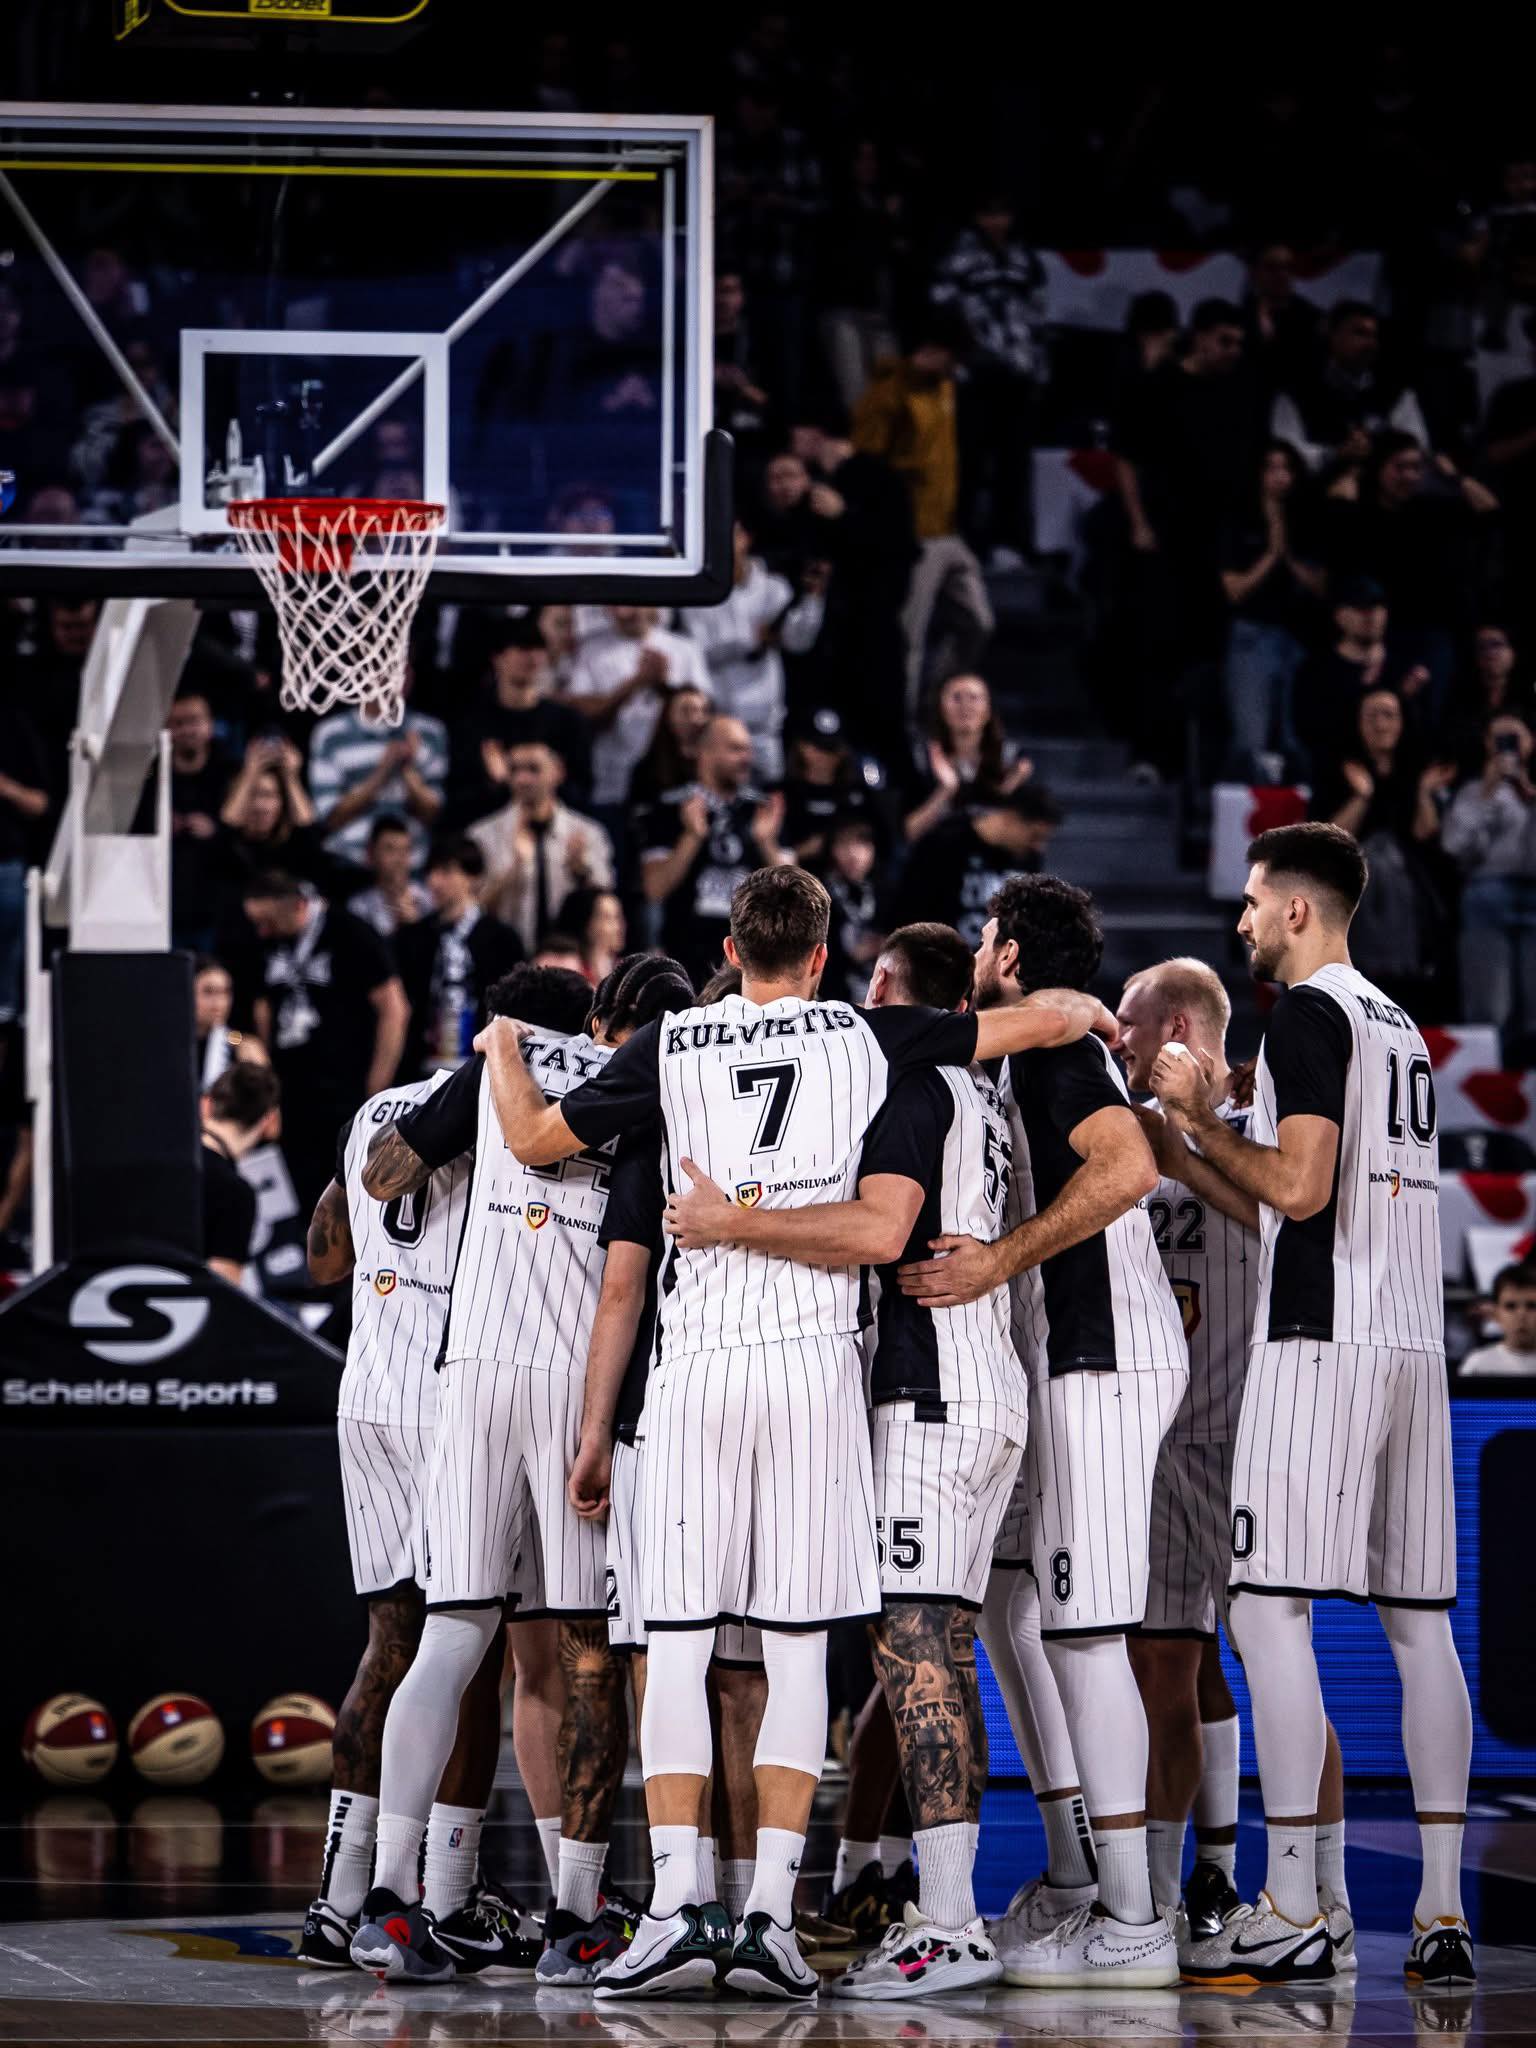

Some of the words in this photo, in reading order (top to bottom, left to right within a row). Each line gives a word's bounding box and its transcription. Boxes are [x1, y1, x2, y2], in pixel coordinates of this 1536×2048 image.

[666, 1007, 856, 1057] KULVIETIS
[729, 1058, 803, 1156] 7
[1387, 1047, 1437, 1148] 10
[488, 1202, 522, 1216] BANCA
[530, 1208, 545, 1219] BT
[741, 1188, 757, 1199] BT
[1147, 1197, 1206, 1254] 22
[379, 1275, 393, 1286] BT
[3, 1379, 150, 1405] Schelde
[156, 1379, 278, 1411] Sports
[1049, 1547, 1073, 1605] 8
